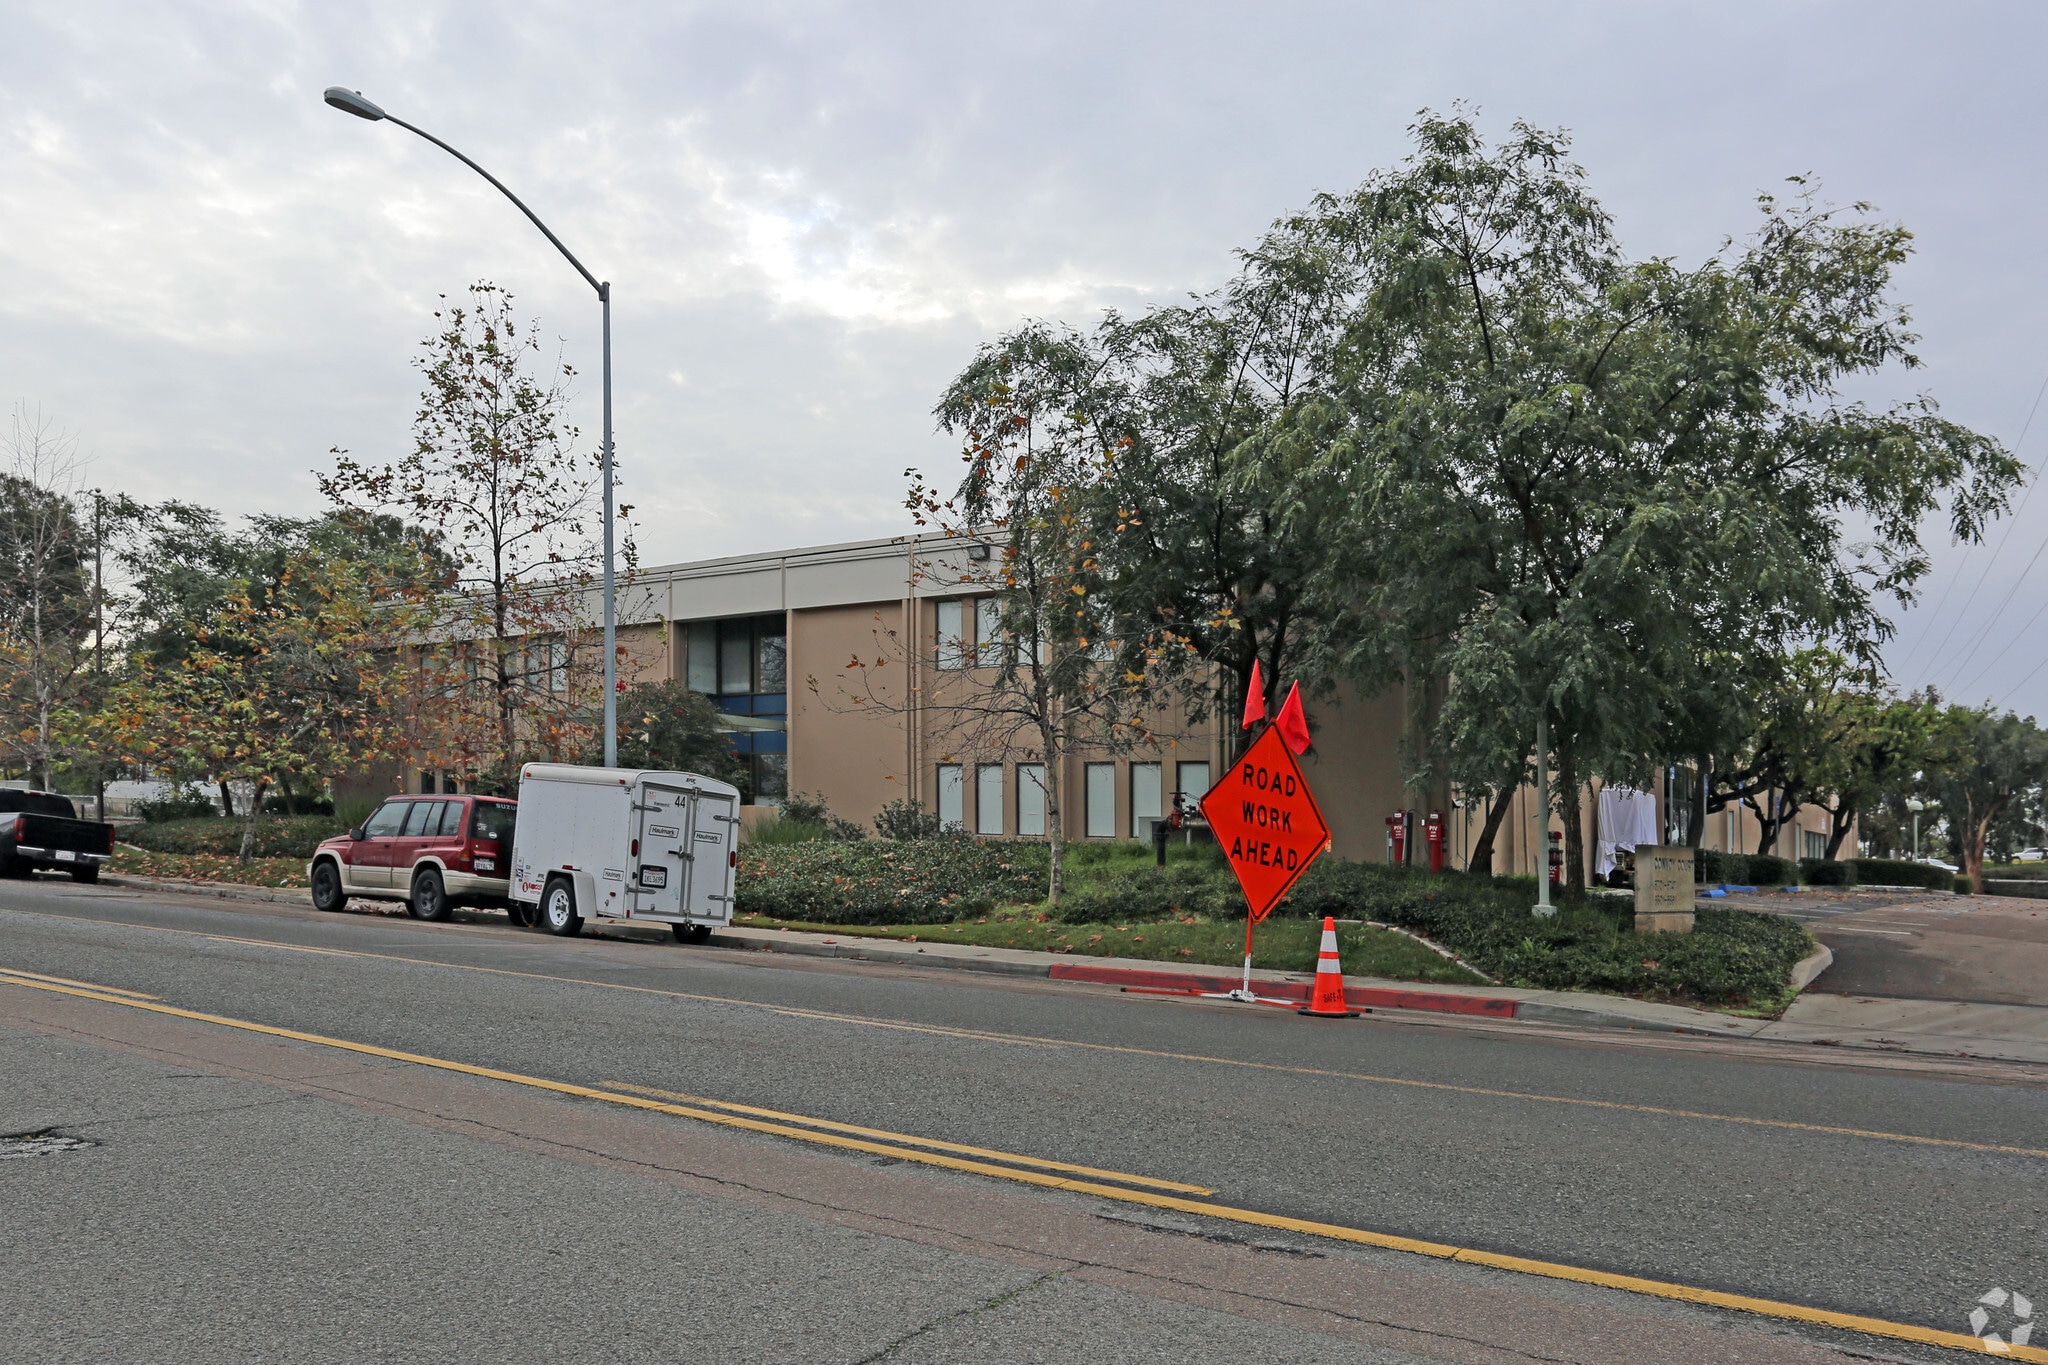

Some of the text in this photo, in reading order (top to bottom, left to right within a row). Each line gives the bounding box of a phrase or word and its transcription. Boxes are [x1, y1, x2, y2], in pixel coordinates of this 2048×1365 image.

[1243, 763, 1296, 797] ROAD
[496, 803, 517, 811] SUZU
[674, 795, 686, 808] 44
[1242, 800, 1292, 834] WORK
[651, 826, 675, 836] Haulmark
[695, 832, 718, 841] Haulmark
[1230, 836, 1298, 872] AHEAD
[605, 871, 621, 879] Haulmark
